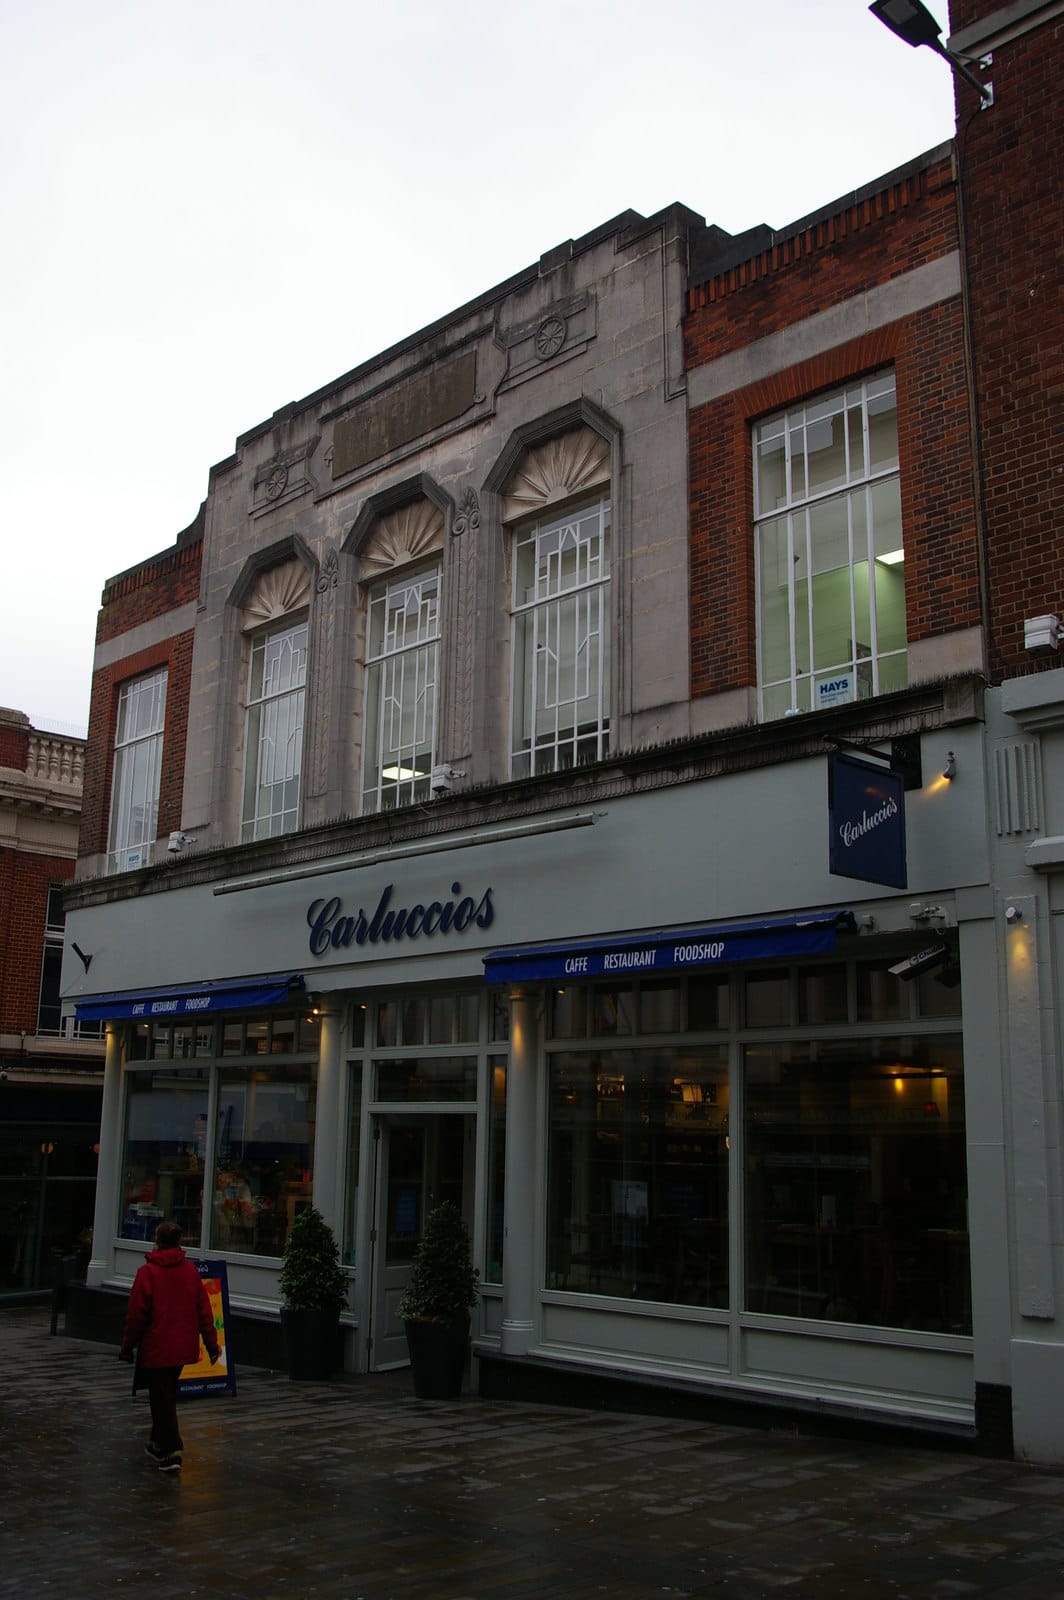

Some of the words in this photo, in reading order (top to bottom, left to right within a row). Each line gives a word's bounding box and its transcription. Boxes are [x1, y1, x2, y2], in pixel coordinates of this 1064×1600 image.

[820, 679, 848, 694] HAYS
[839, 797, 898, 847] Carluccio's
[306, 881, 494, 955] Carluccios
[564, 956, 589, 973] CAFFE
[604, 950, 656, 969] RESTAURANT
[673, 942, 725, 962] FOODSHOP
